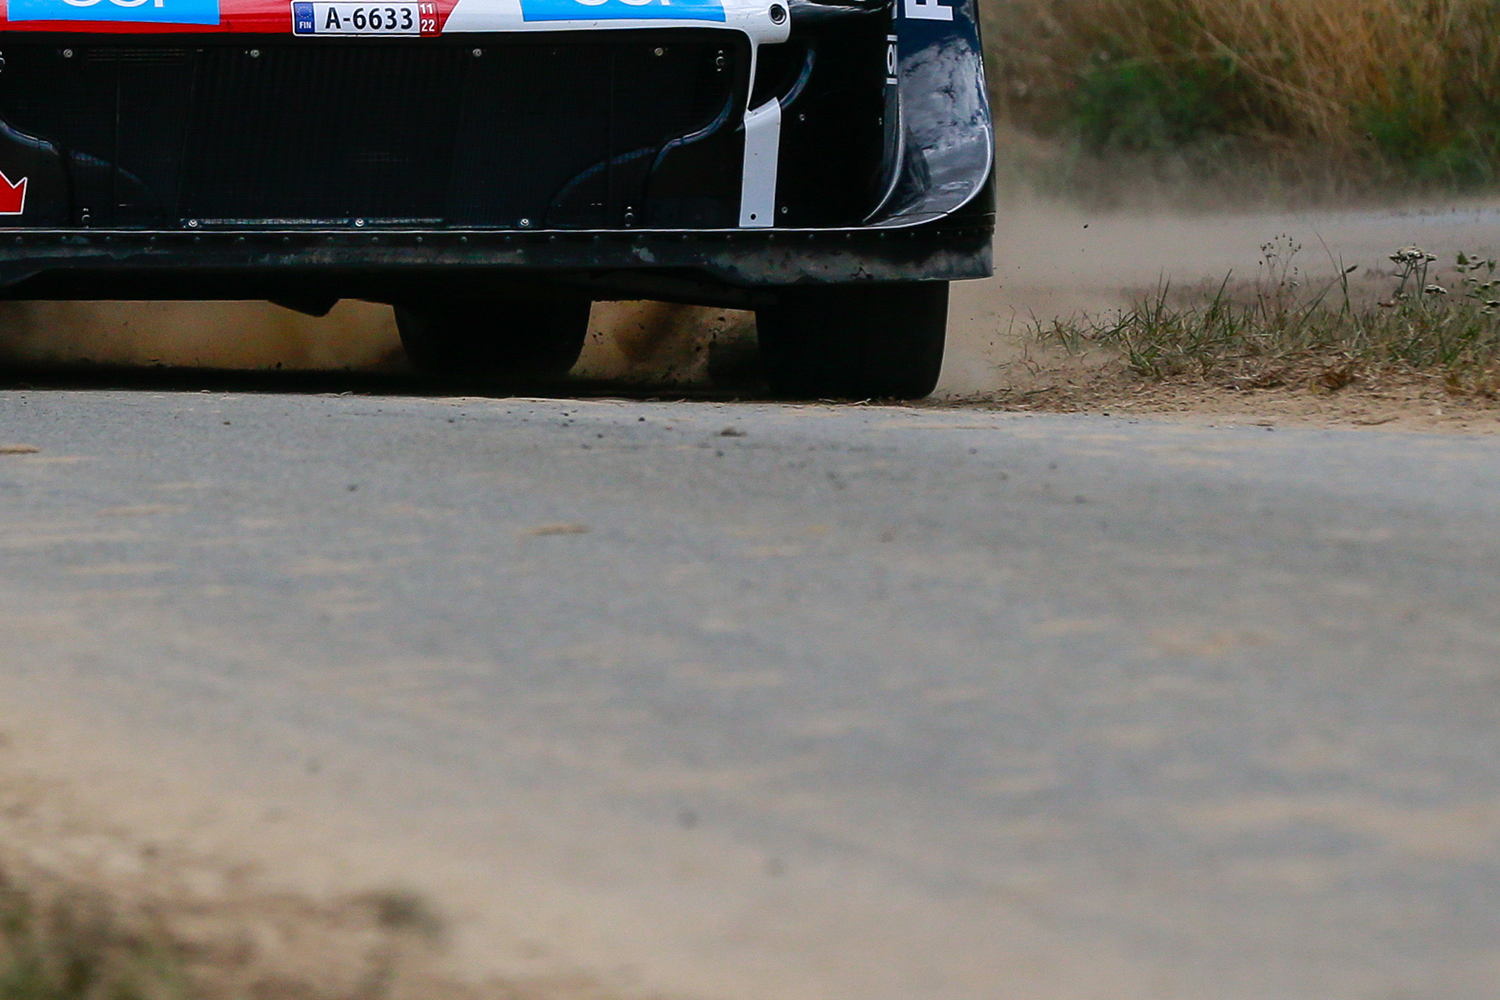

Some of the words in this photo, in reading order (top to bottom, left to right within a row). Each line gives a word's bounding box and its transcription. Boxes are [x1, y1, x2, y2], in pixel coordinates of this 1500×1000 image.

[419, 3, 434, 15] 11
[325, 6, 413, 30] A-6633
[299, 21, 312, 30] FIN
[420, 18, 436, 32] 22
